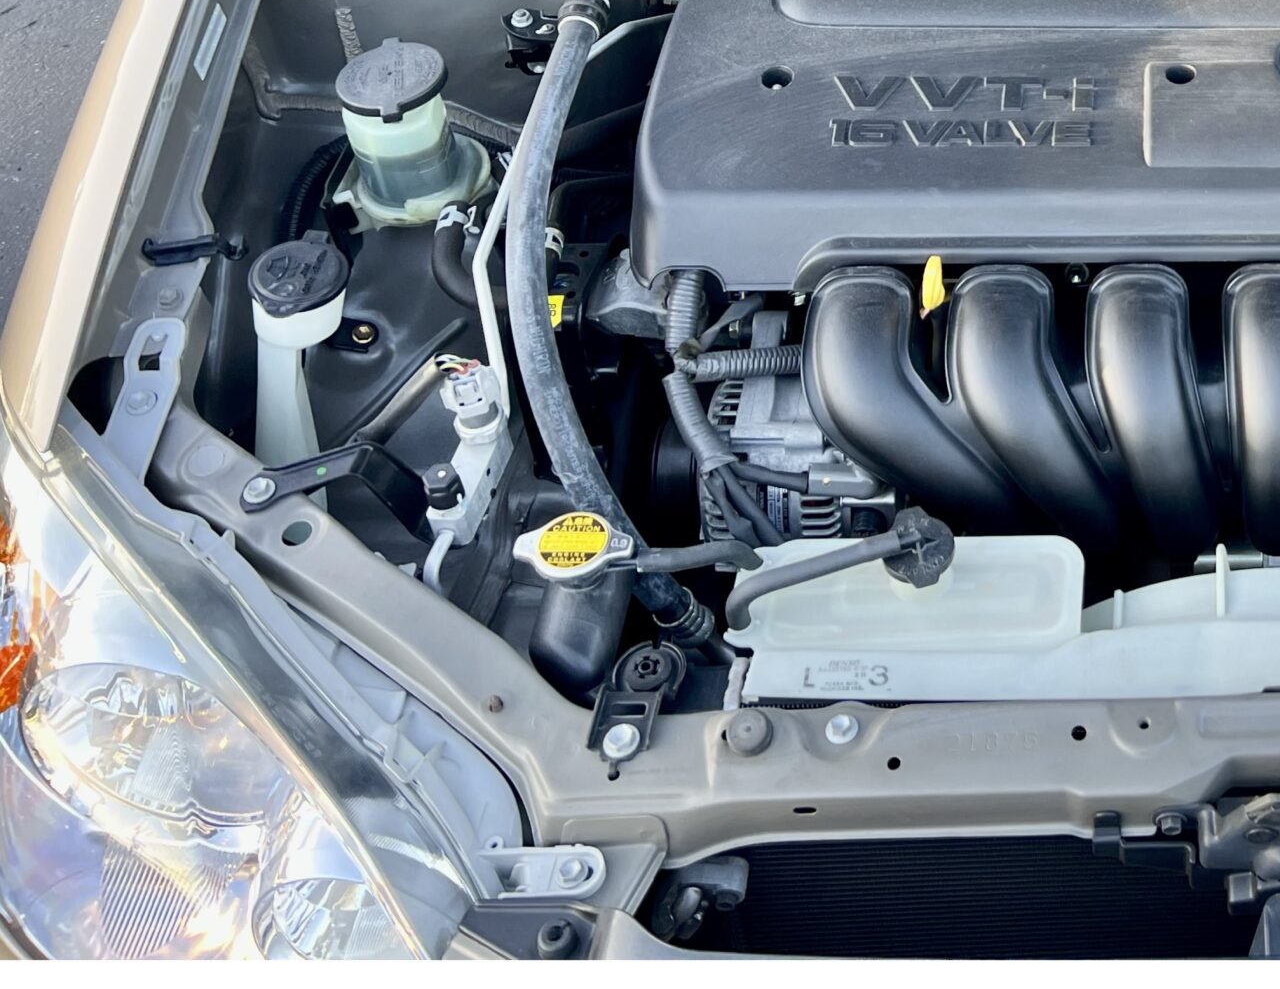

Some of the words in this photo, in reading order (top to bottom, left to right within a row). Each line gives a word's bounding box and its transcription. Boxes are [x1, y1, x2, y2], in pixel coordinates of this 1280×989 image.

[834, 75, 1097, 112] VVT-i
[803, 666, 815, 688] L
[868, 664, 889, 687] 3
